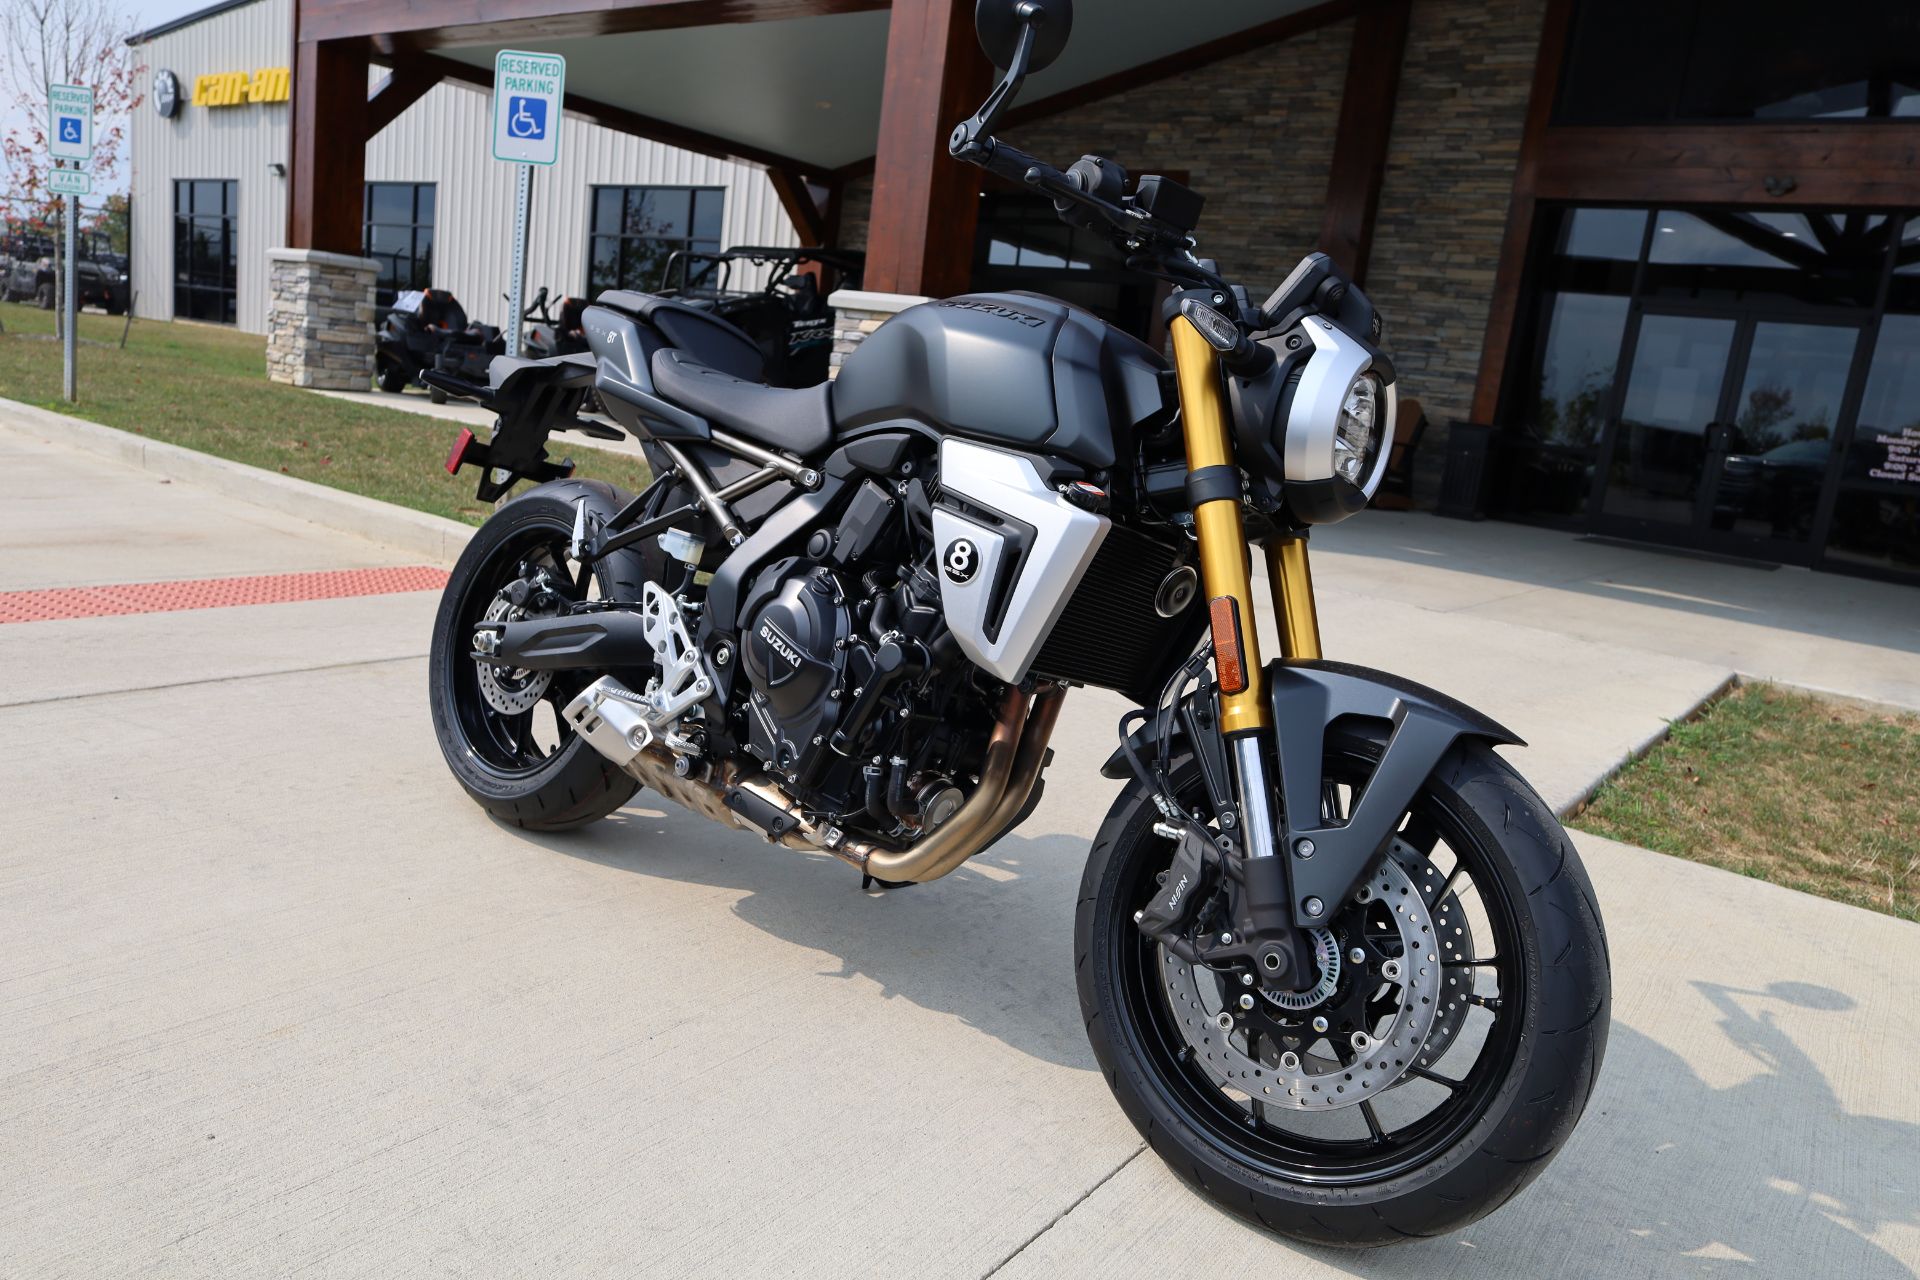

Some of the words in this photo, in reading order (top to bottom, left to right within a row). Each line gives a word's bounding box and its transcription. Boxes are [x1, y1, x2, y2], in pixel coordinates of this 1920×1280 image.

[501, 58, 560, 77] RESERVED
[192, 67, 291, 107] can-am
[505, 76, 554, 95] PARKING
[52, 90, 91, 104] RESERVED
[54, 103, 87, 116] PARKING
[59, 174, 81, 184] VAN
[950, 541, 971, 571] 8
[760, 625, 801, 668] SUZUKI
